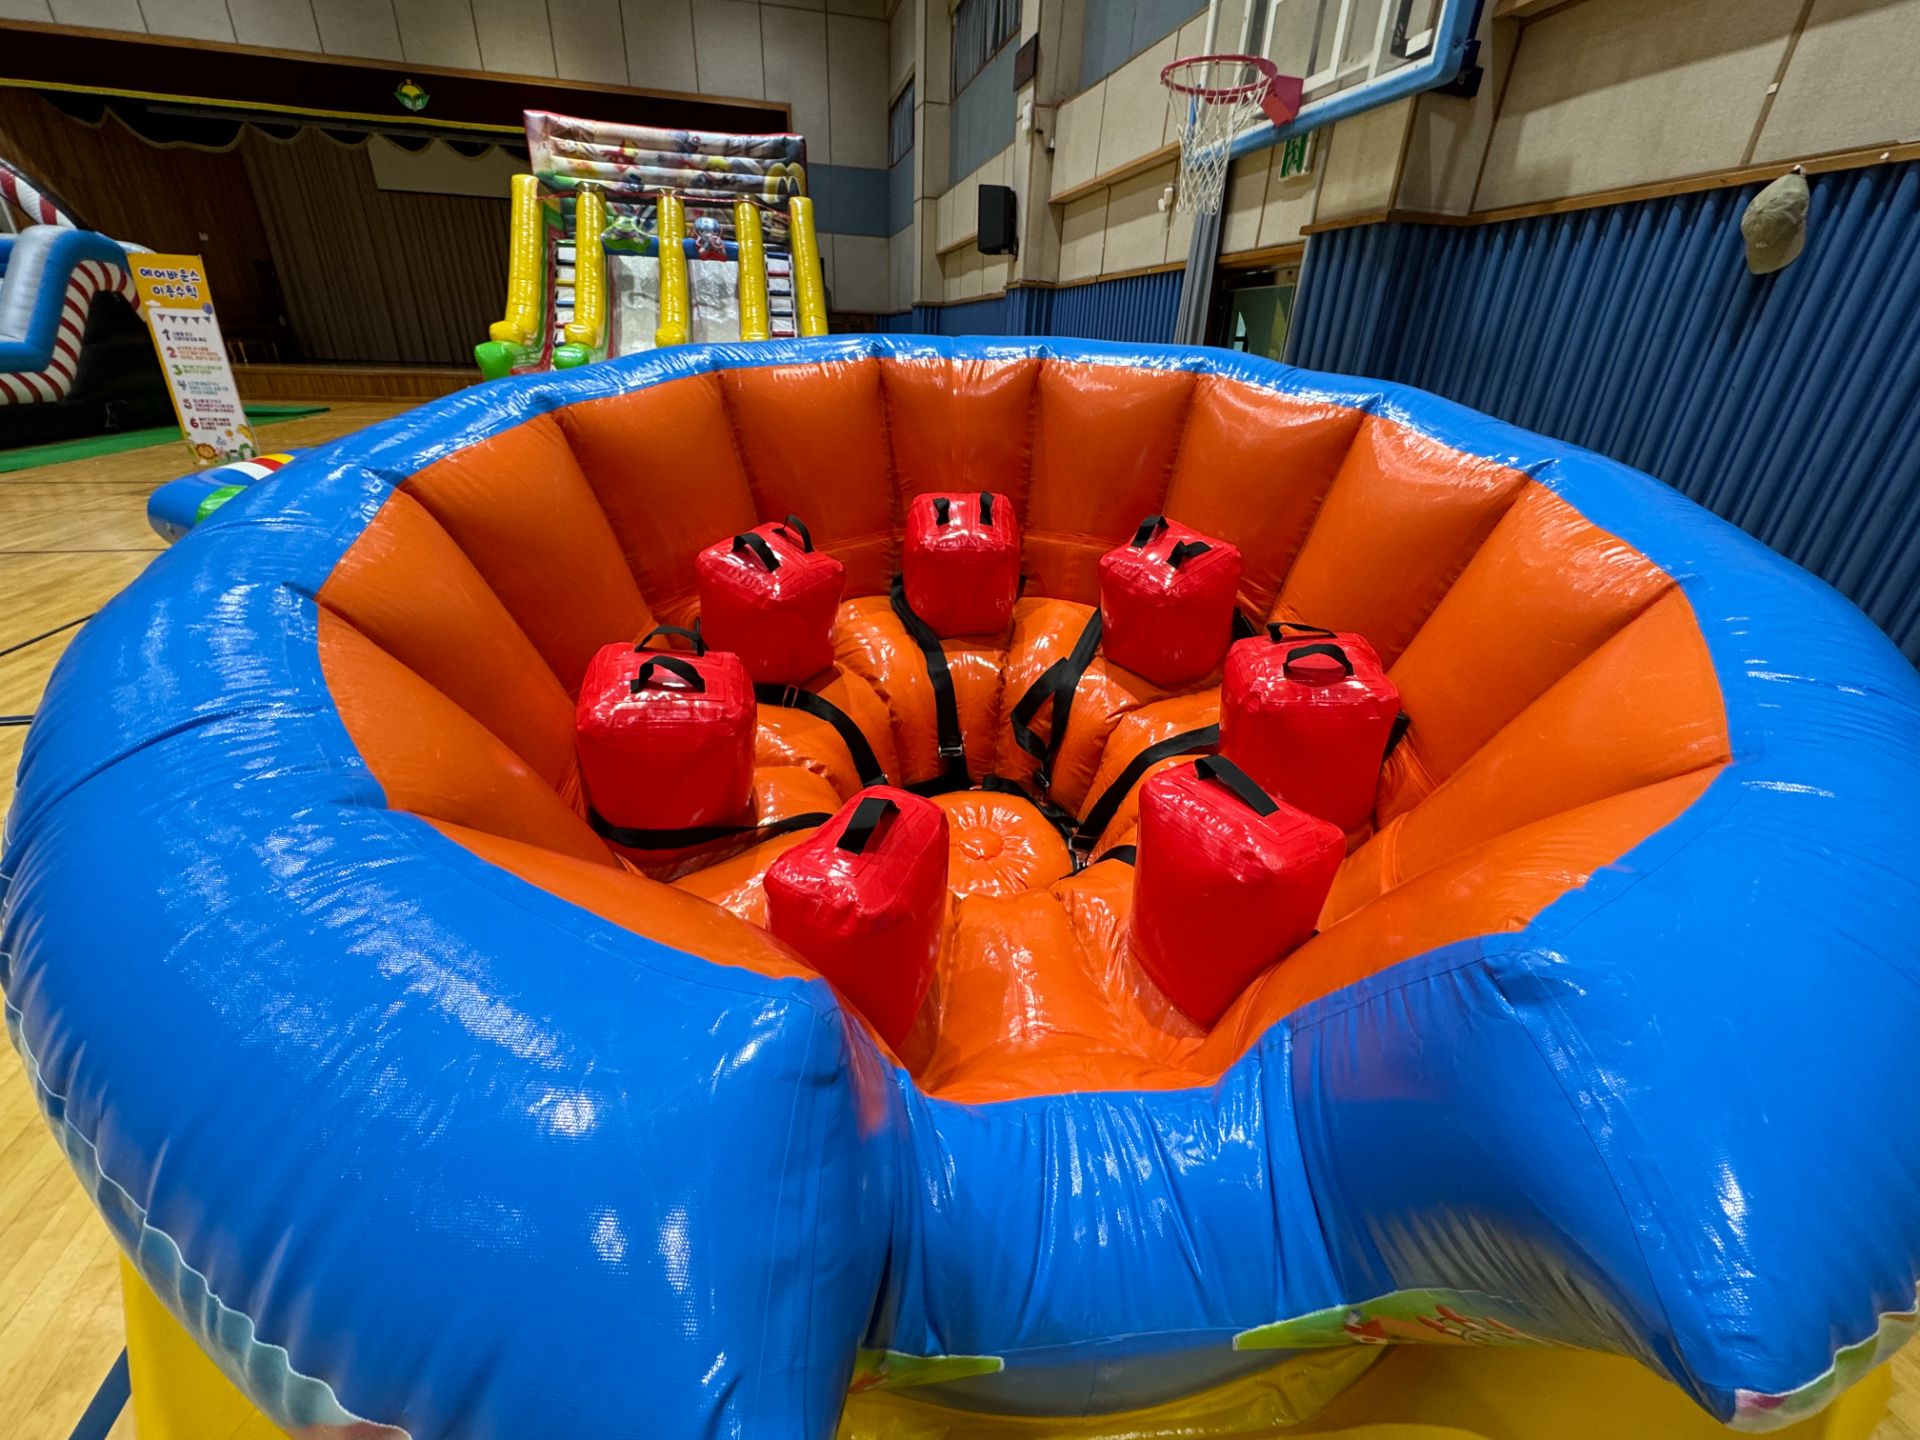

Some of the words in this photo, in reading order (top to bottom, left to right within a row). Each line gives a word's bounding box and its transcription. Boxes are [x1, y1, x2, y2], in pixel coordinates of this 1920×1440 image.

[140, 268, 200, 282] 에어바운스
[152, 285, 198, 298] 이용수칙
[162, 328, 171, 341] 1
[166, 346, 177, 358] 2
[172, 364, 183, 375] 3
[177, 380, 187, 391] 4
[183, 398, 193, 410] 5
[190, 418, 199, 429] 6
